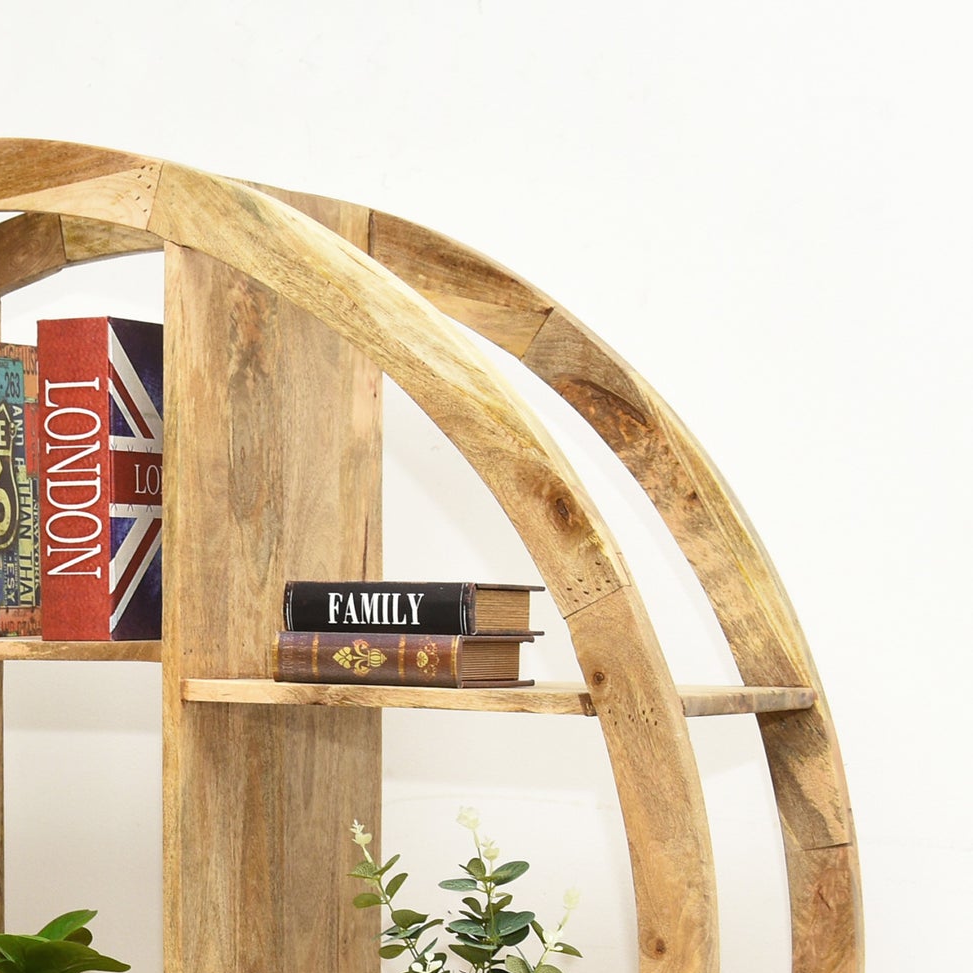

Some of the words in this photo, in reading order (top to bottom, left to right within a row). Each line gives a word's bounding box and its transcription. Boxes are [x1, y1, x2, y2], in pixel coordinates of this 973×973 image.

[43, 377, 102, 579] LONDON
[134, 463, 163, 495] LO
[18, 479, 33, 540] THAN
[19, 551, 34, 606] THAT
[327, 592, 425, 626] FAMILY
